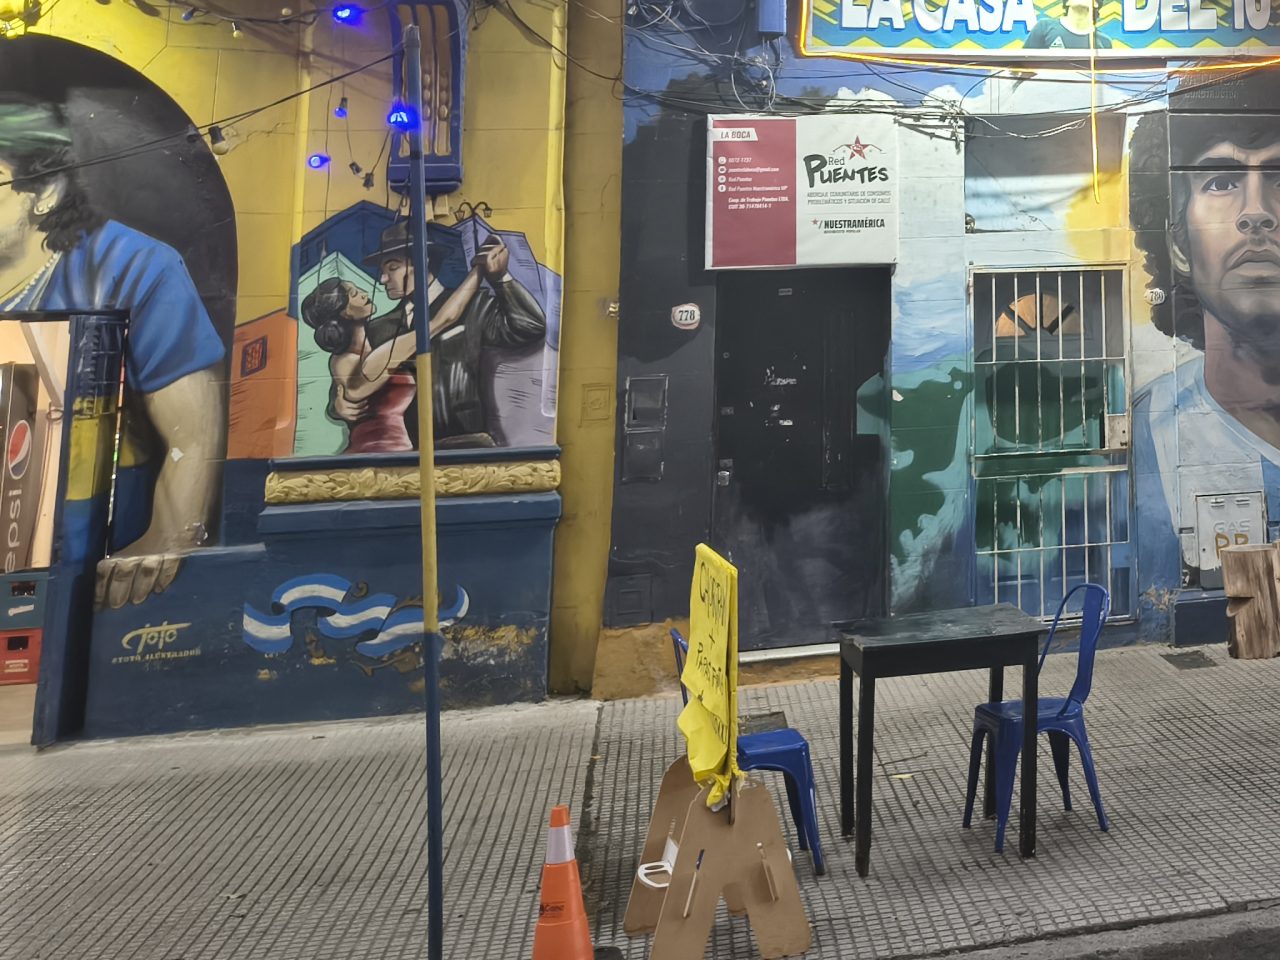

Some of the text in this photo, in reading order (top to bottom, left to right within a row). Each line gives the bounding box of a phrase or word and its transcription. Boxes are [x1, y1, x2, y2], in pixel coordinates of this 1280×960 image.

[720, 130, 751, 139] LA BOCA
[828, 156, 845, 166] Red
[824, 217, 885, 229] NUESTRAMÉRICA
[678, 309, 696, 321] 778
[4, 487, 23, 574] epsi
[1213, 519, 1251, 533] GAS
